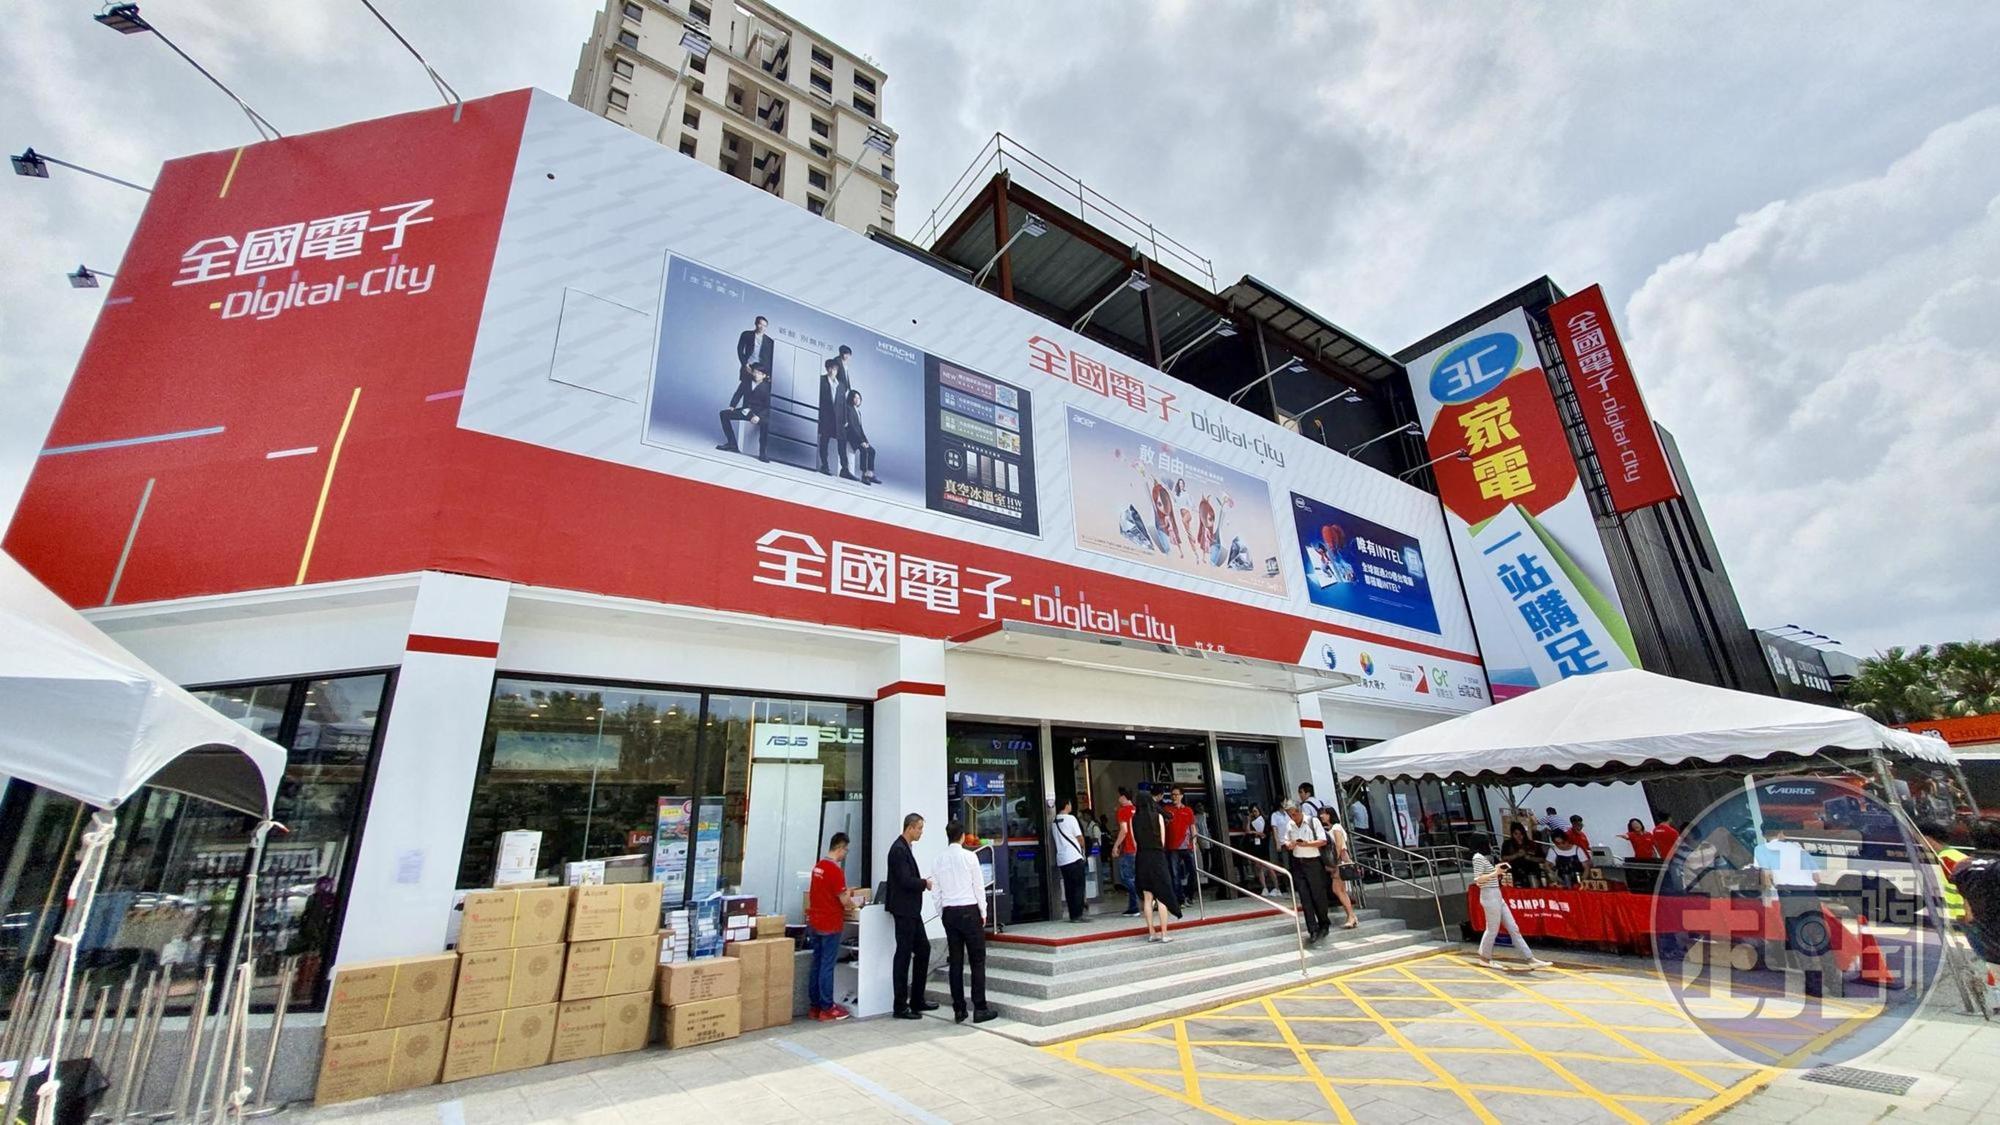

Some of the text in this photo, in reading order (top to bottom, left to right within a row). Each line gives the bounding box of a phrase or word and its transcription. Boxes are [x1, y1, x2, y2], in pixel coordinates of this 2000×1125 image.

[172, 199, 434, 287] 全國電子
[878, 340, 916, 360] HITACHI
[1568, 310, 1619, 393] 全國電子
[1028, 335, 1180, 422] 全國電子
[1440, 344, 1508, 397] 3C
[1072, 413, 1096, 429] acer
[1458, 397, 1536, 500] 家電
[1158, 452, 1184, 477] 自由
[753, 528, 1017, 619] 全國電子
[1483, 531, 1608, 678] 一站購足
[766, 735, 808, 746] ASUS
[818, 726, 864, 744] SUS
[955, 757, 1019, 766] CASHIER INFORMATION
[1775, 787, 1816, 796] AORUS
[1509, 898, 1546, 910] SAMPO
